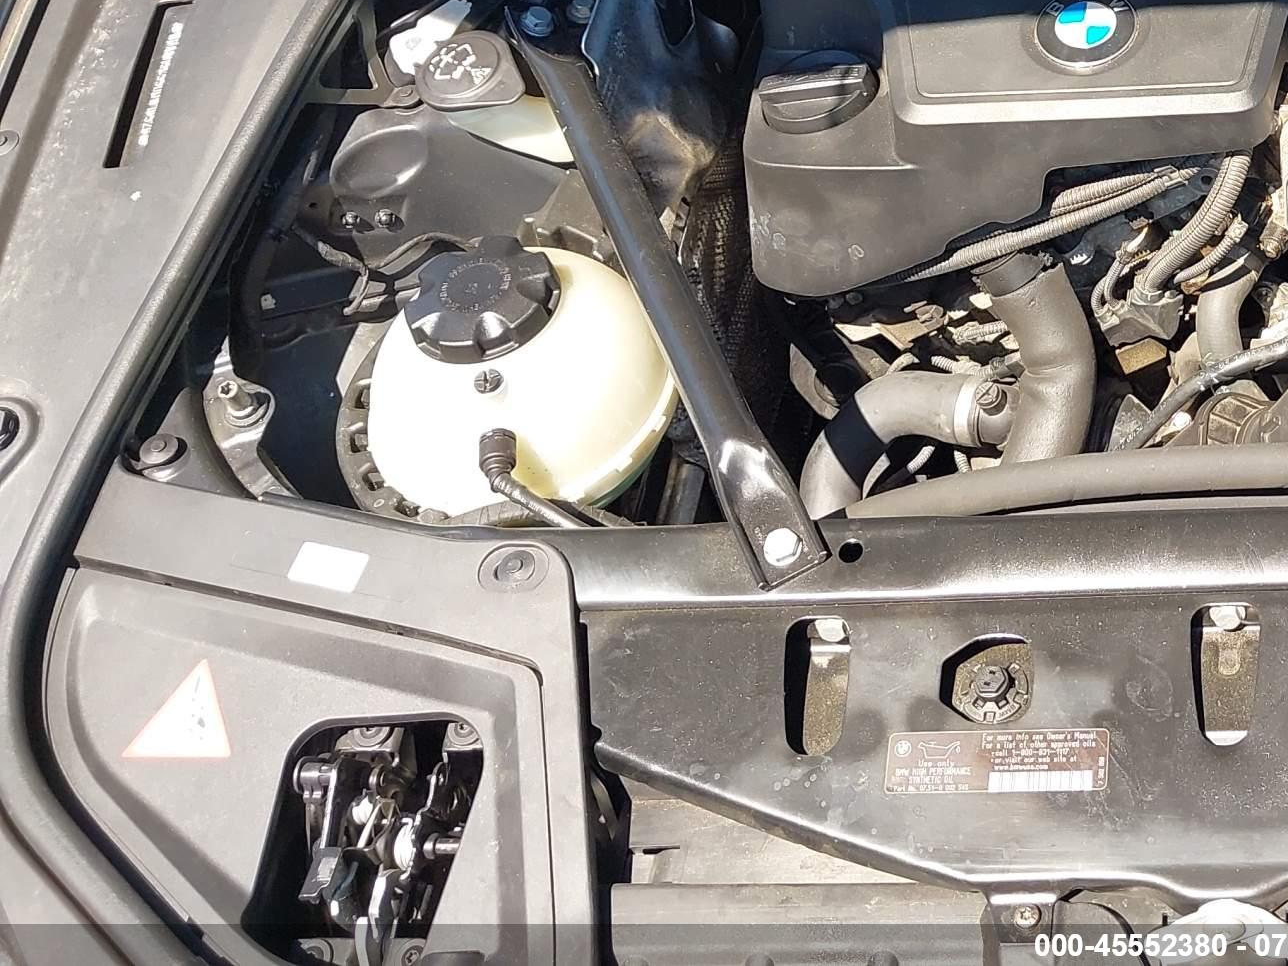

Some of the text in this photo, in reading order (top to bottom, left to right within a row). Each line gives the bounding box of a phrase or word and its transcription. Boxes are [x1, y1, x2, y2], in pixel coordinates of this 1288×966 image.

[982, 733, 993, 741] For
[1016, 732, 1029, 740] info
[1046, 732, 1071, 740] Owner's
[982, 741, 993, 749] For
[1004, 741, 1016, 749] list
[1030, 740, 1047, 748] other
[1050, 740, 1080, 749] approved
[936, 758, 955, 767] only
[1038, 755, 1051, 763] web
[928, 766, 972, 776] PERFORMANCE
[908, 776, 942, 784] SYNTHETIC
